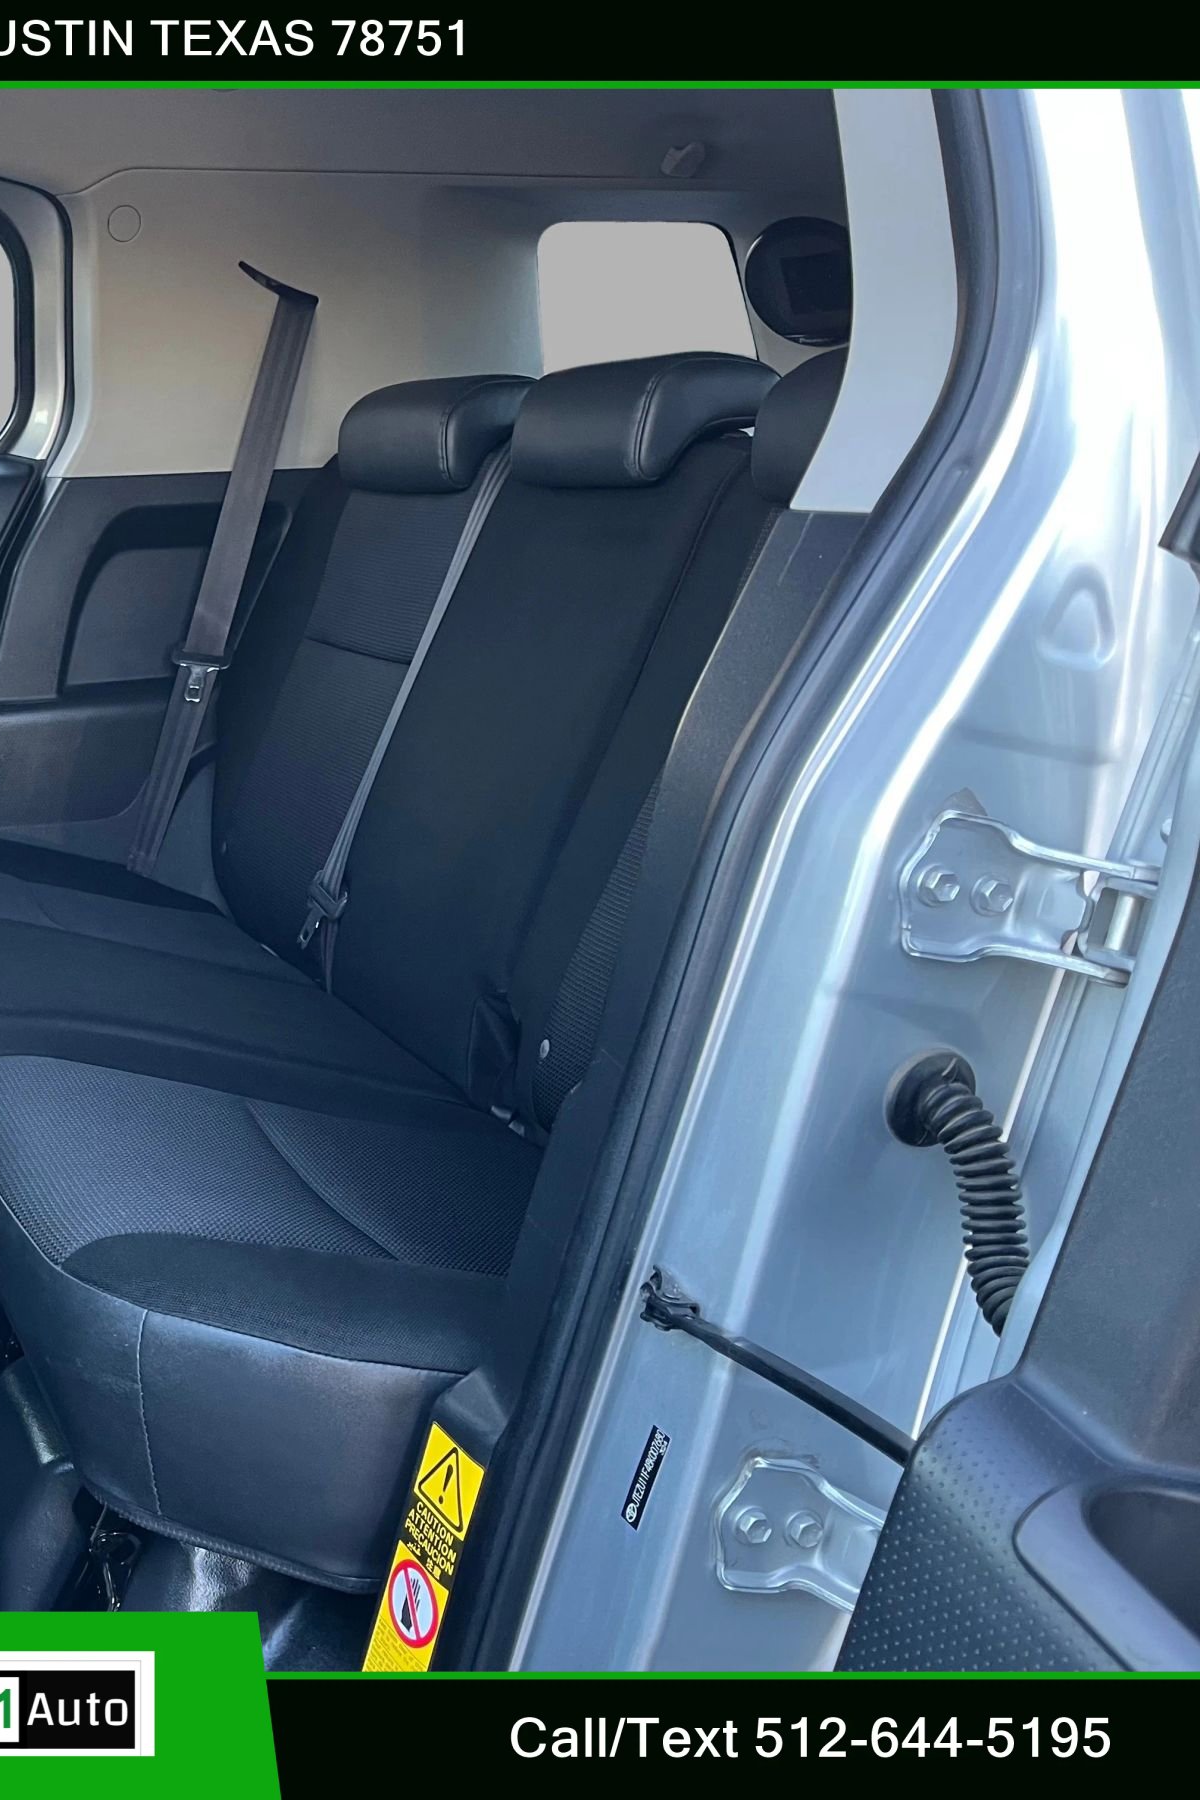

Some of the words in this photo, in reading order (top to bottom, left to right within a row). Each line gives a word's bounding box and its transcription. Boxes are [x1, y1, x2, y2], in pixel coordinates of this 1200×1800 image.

[404, 1518, 454, 1576] PRECAUCION
[408, 1508, 457, 1562] ATTENTION
[416, 1501, 453, 1546] CAUTION
